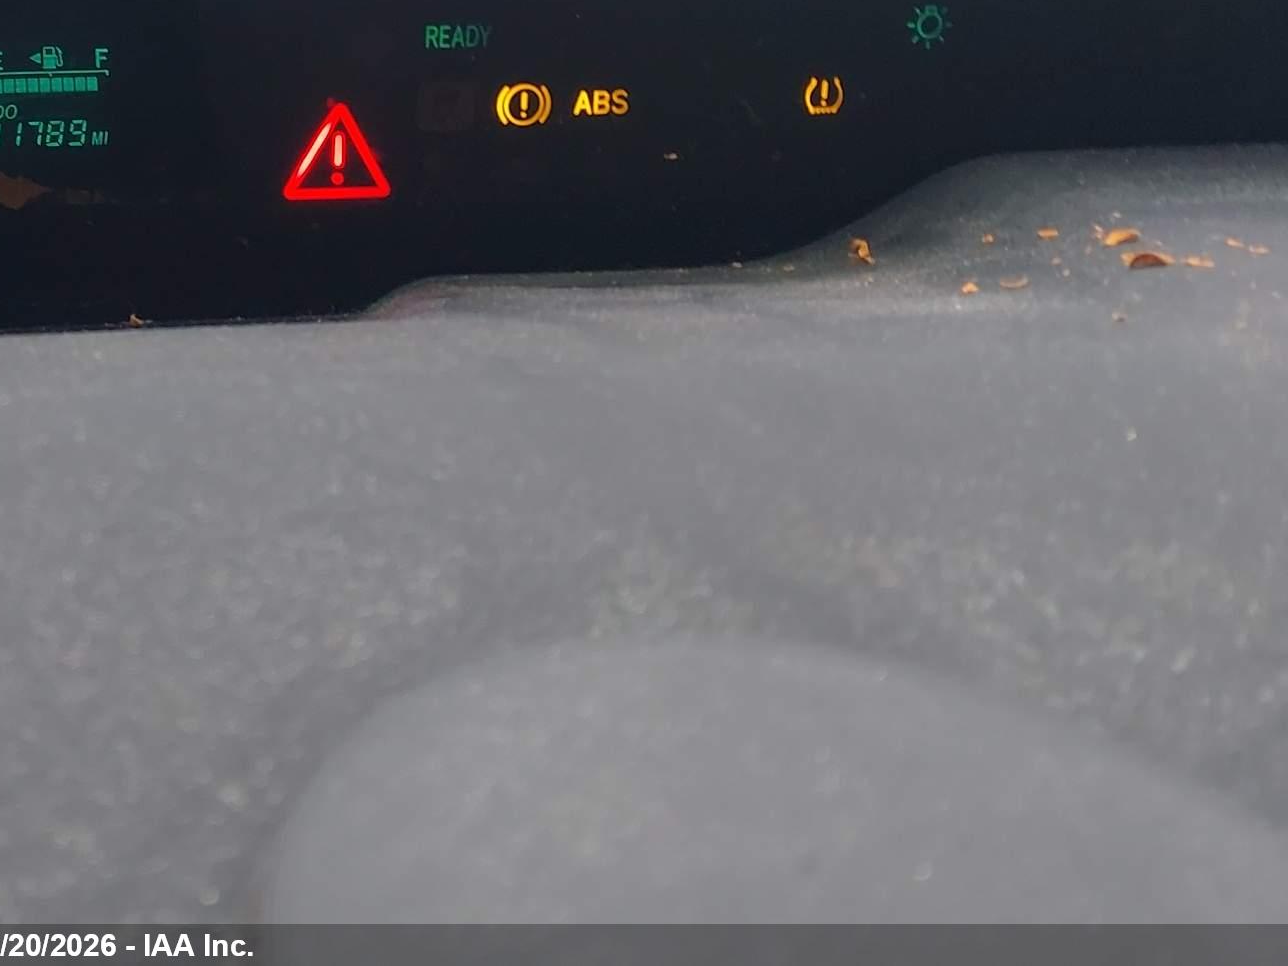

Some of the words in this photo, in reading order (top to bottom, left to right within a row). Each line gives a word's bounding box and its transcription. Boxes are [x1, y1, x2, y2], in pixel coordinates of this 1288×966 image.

[425, 25, 492, 49] READY
[95, 48, 109, 69] F
[573, 89, 629, 116] ABS
[91, 131, 109, 146] MI
